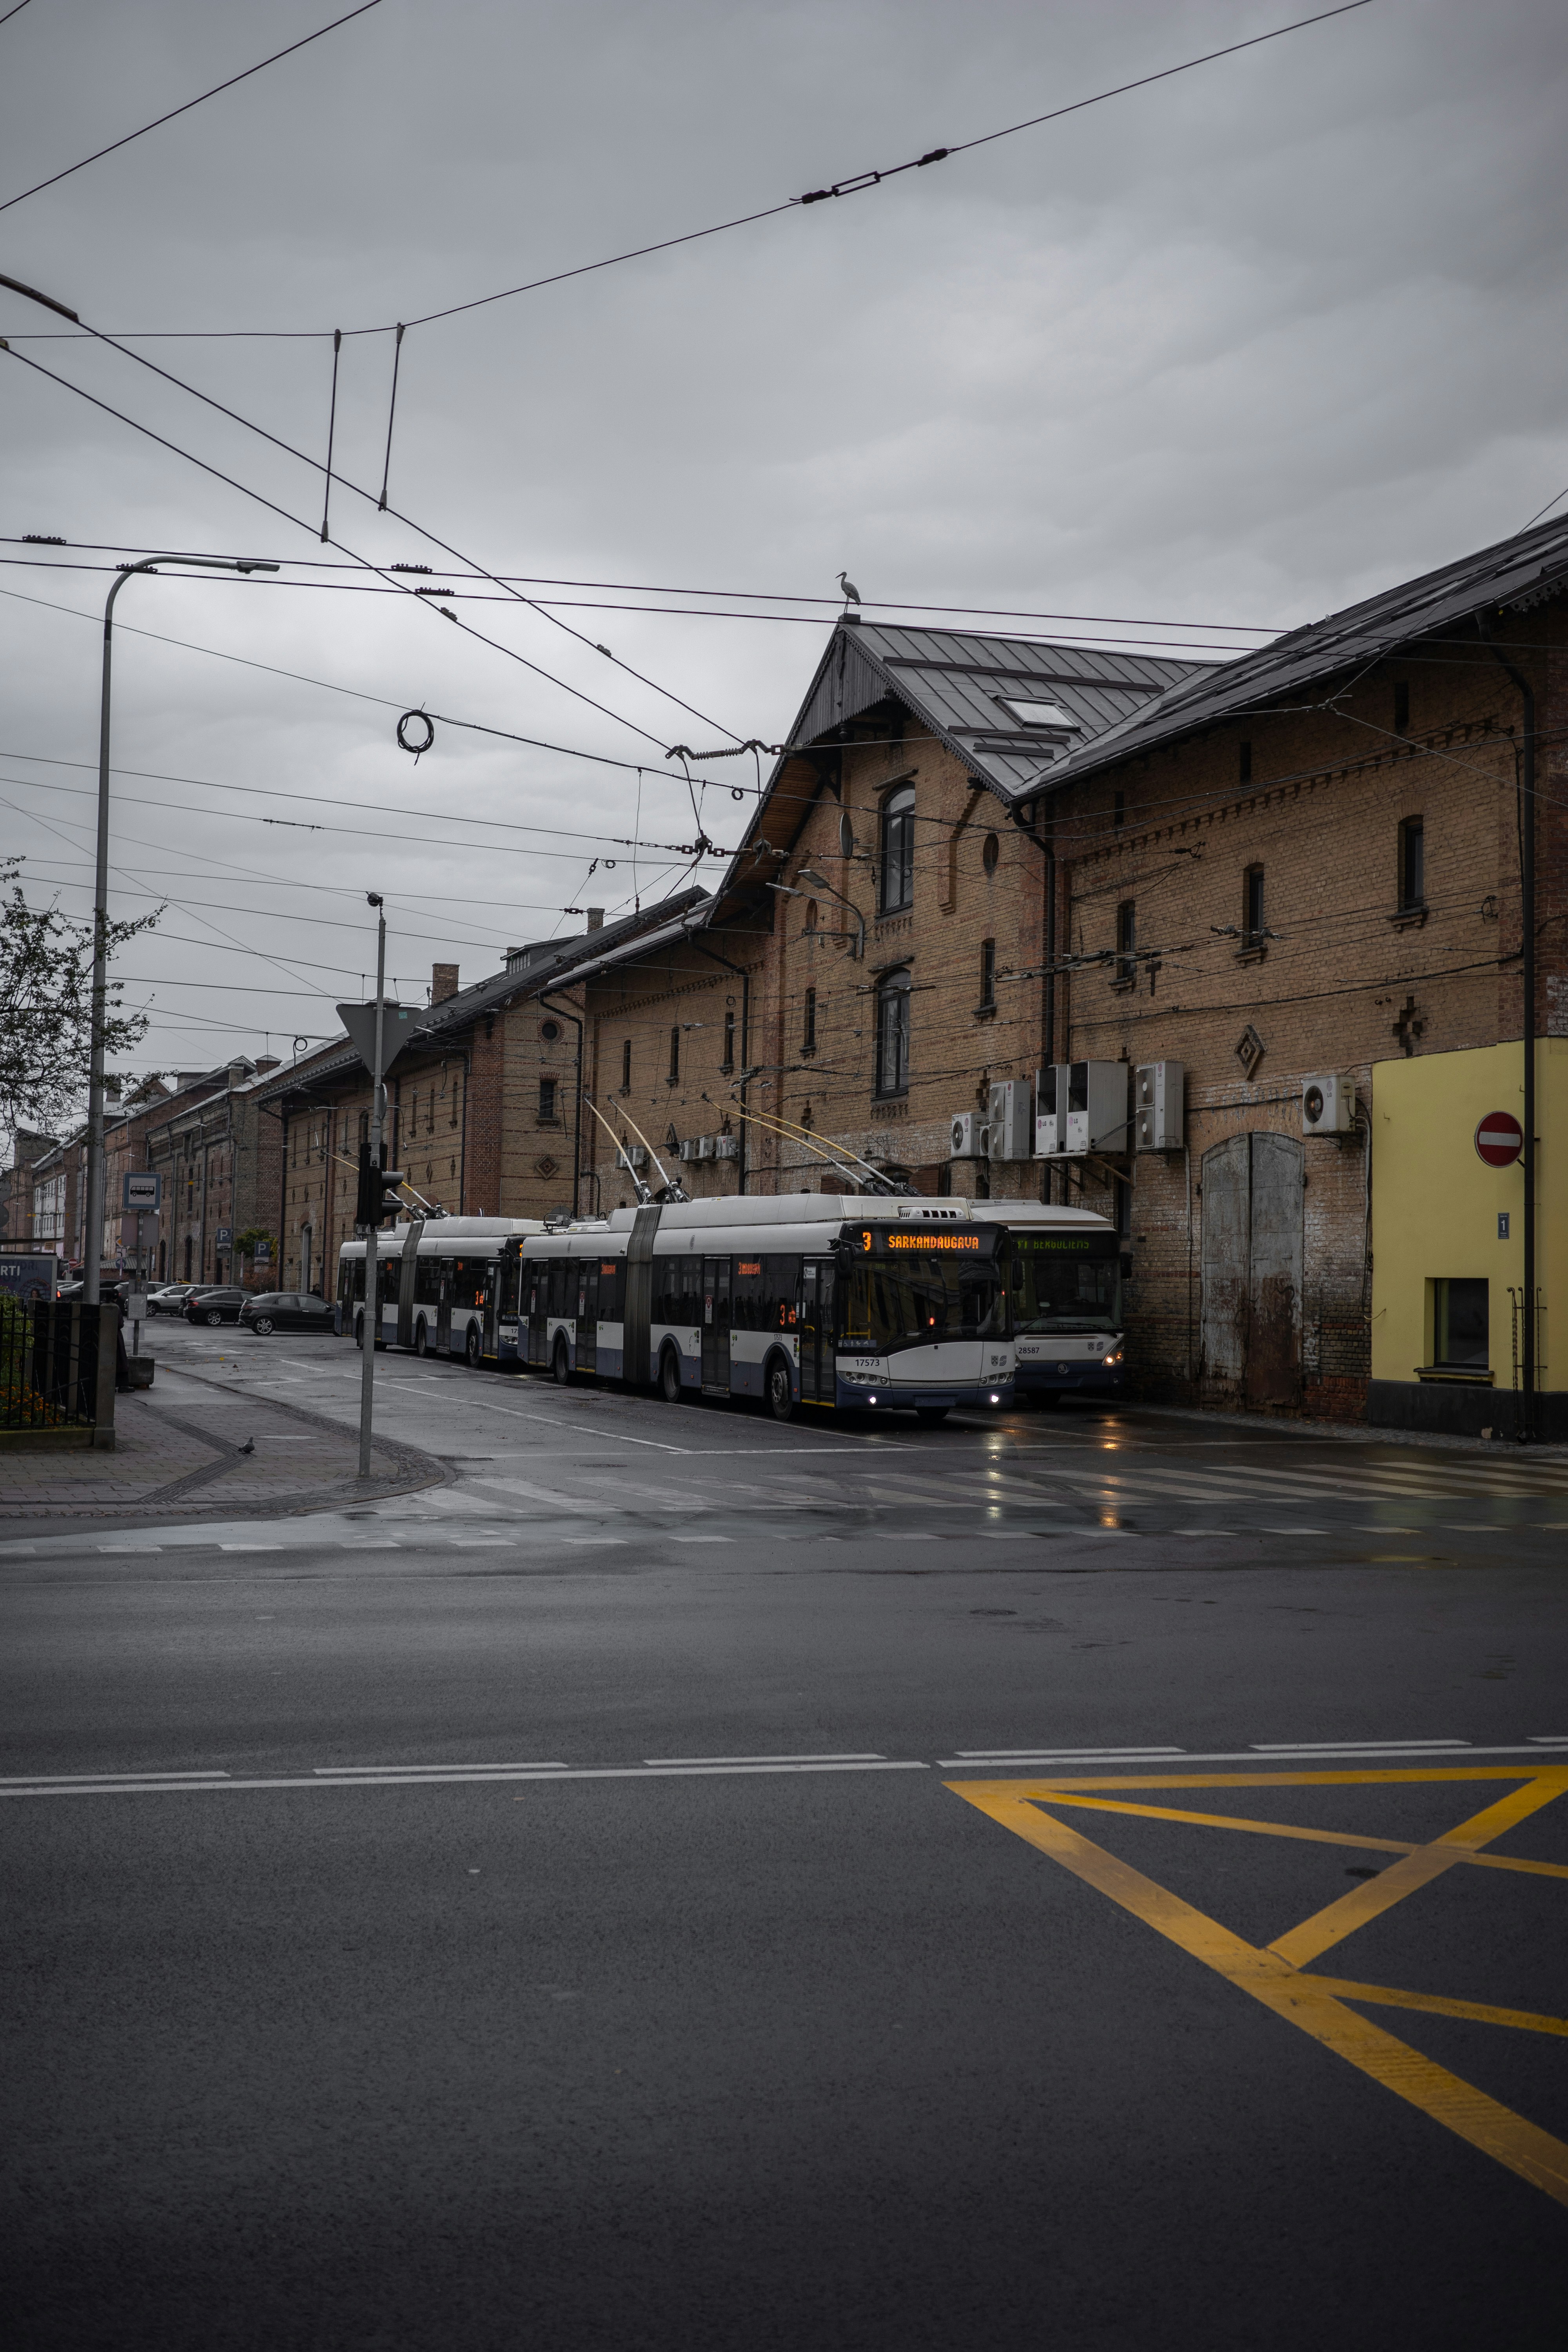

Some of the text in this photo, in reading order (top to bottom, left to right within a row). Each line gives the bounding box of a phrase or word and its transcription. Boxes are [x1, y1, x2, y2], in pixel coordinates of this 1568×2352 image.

[1501, 1220, 1505, 1230] 1
[220, 1230, 228, 1241] P
[863, 1232, 978, 1250] 3 SARKANDAUGAVA
[258, 1243, 266, 1254] P
[1, 1265, 20, 1276] RTI
[780, 1305, 785, 1325] 3
